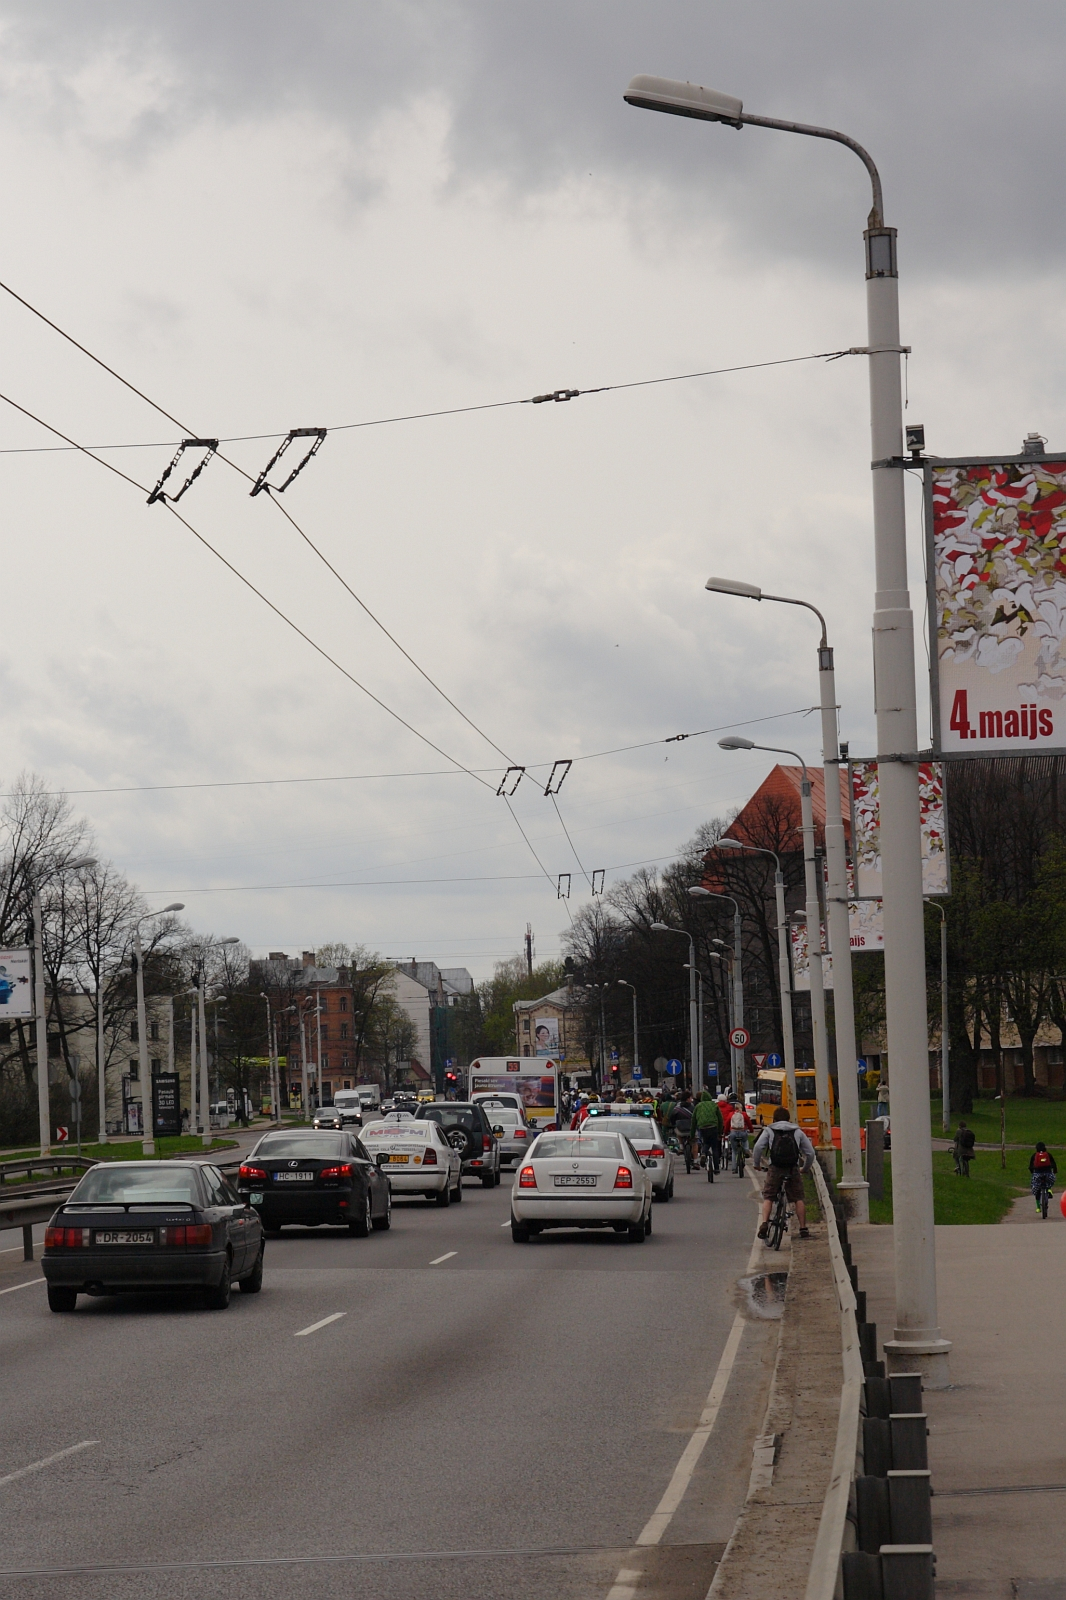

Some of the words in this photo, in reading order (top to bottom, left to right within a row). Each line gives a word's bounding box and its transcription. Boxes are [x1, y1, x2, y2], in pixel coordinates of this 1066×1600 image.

[849, 935, 865, 947] aijs
[734, 1034, 745, 1044] 50
[279, 1172, 313, 1180] HC-1911
[560, 1177, 595, 1185] EP-2553
[103, 1232, 152, 1243] DR-2054
